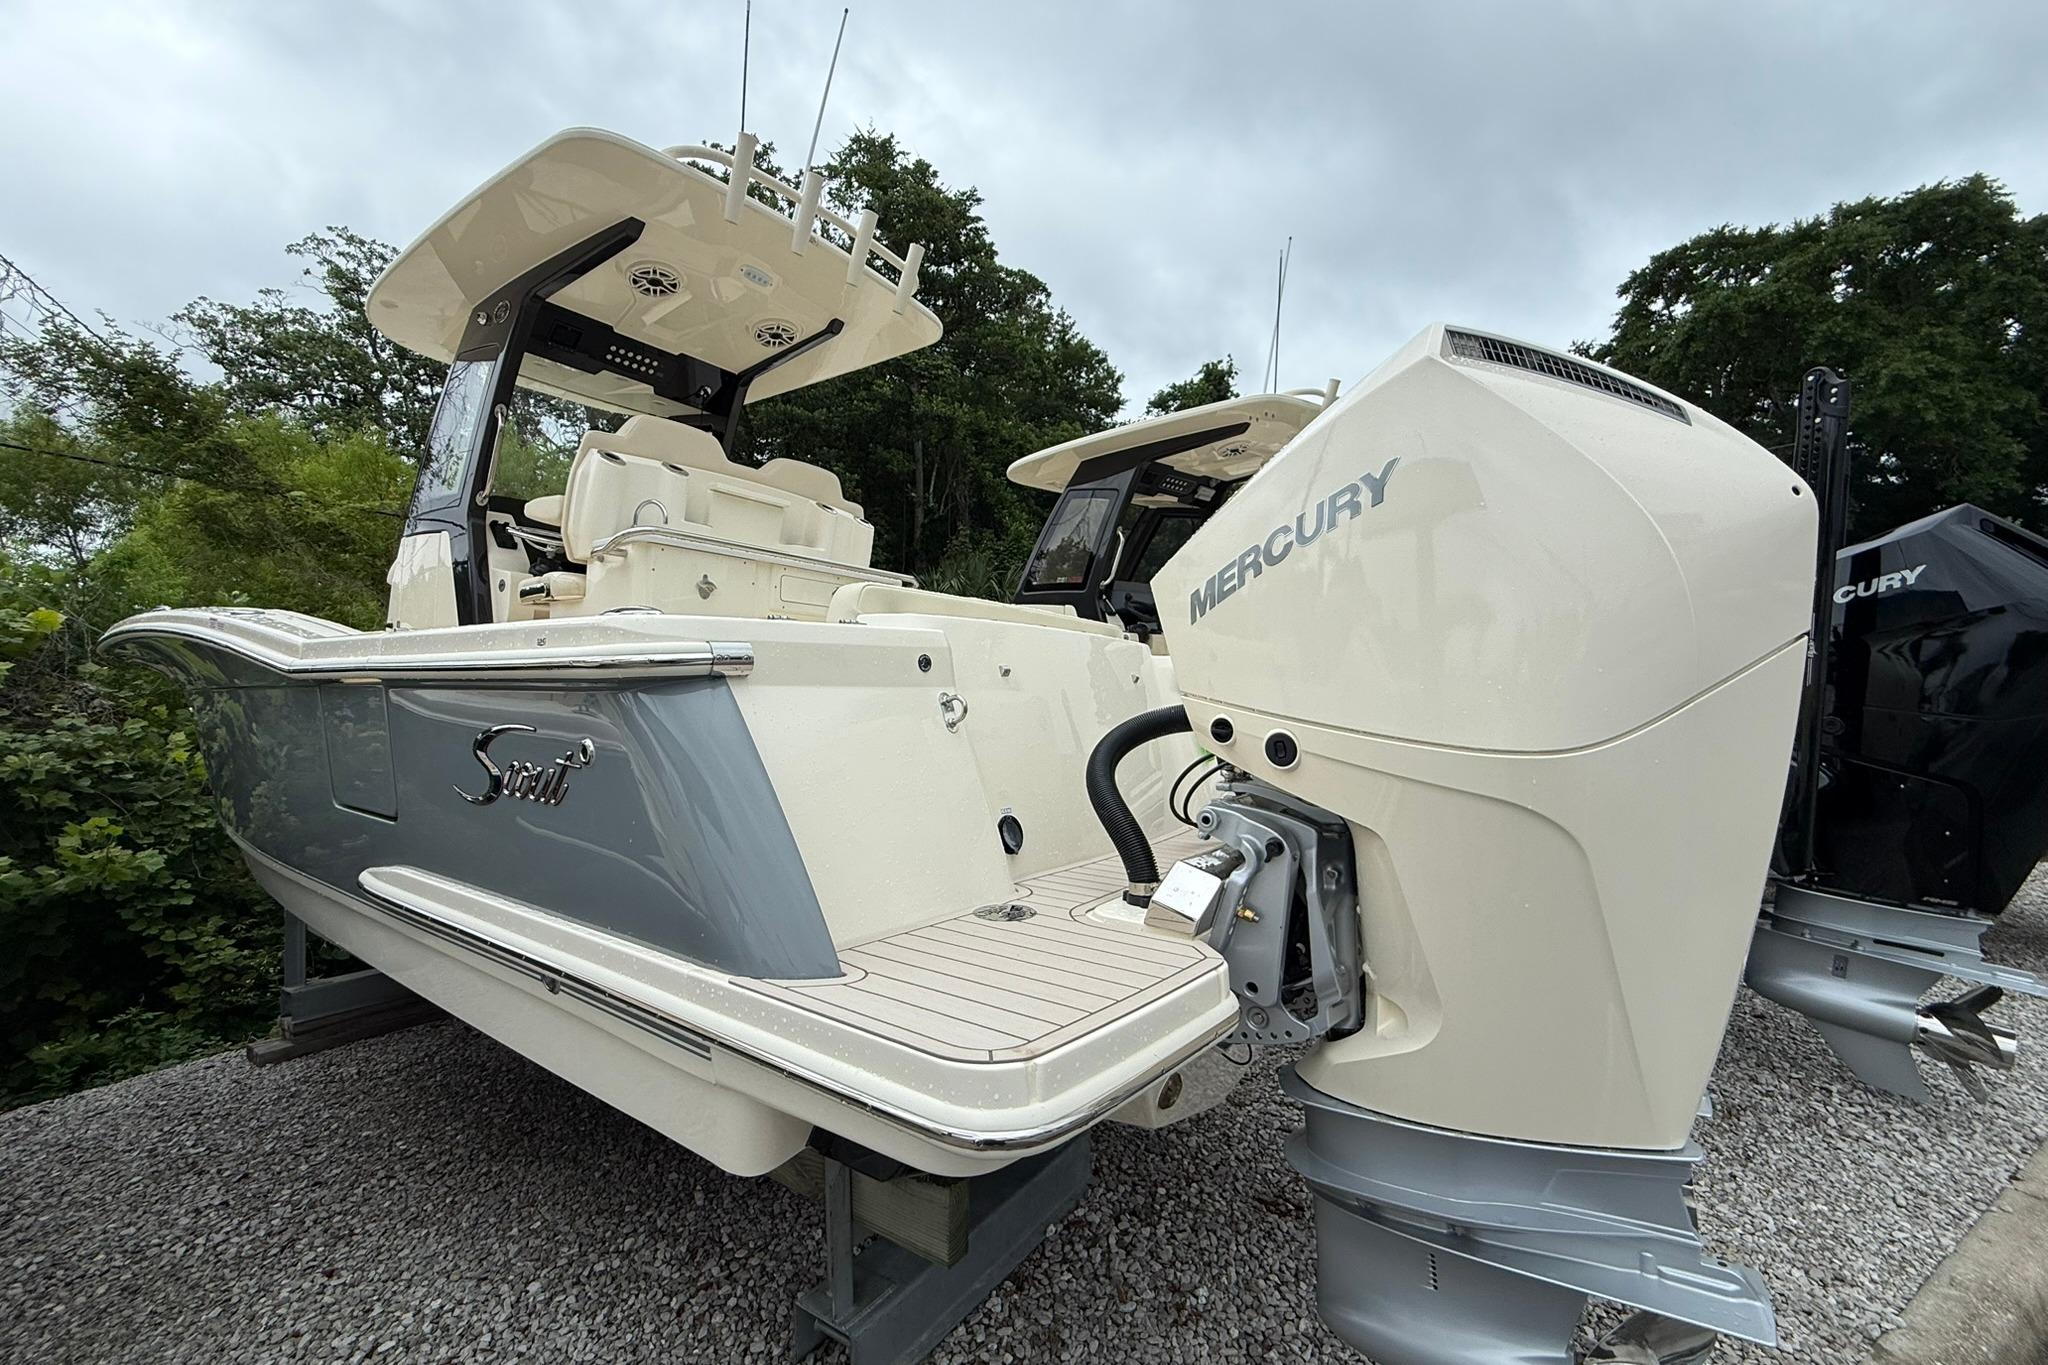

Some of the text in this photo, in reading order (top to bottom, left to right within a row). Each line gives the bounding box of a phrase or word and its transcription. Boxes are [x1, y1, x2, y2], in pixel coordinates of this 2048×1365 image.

[1190, 456, 1401, 626] MERCURY
[1832, 564, 1928, 604] CURY
[452, 723, 583, 806] Scout
